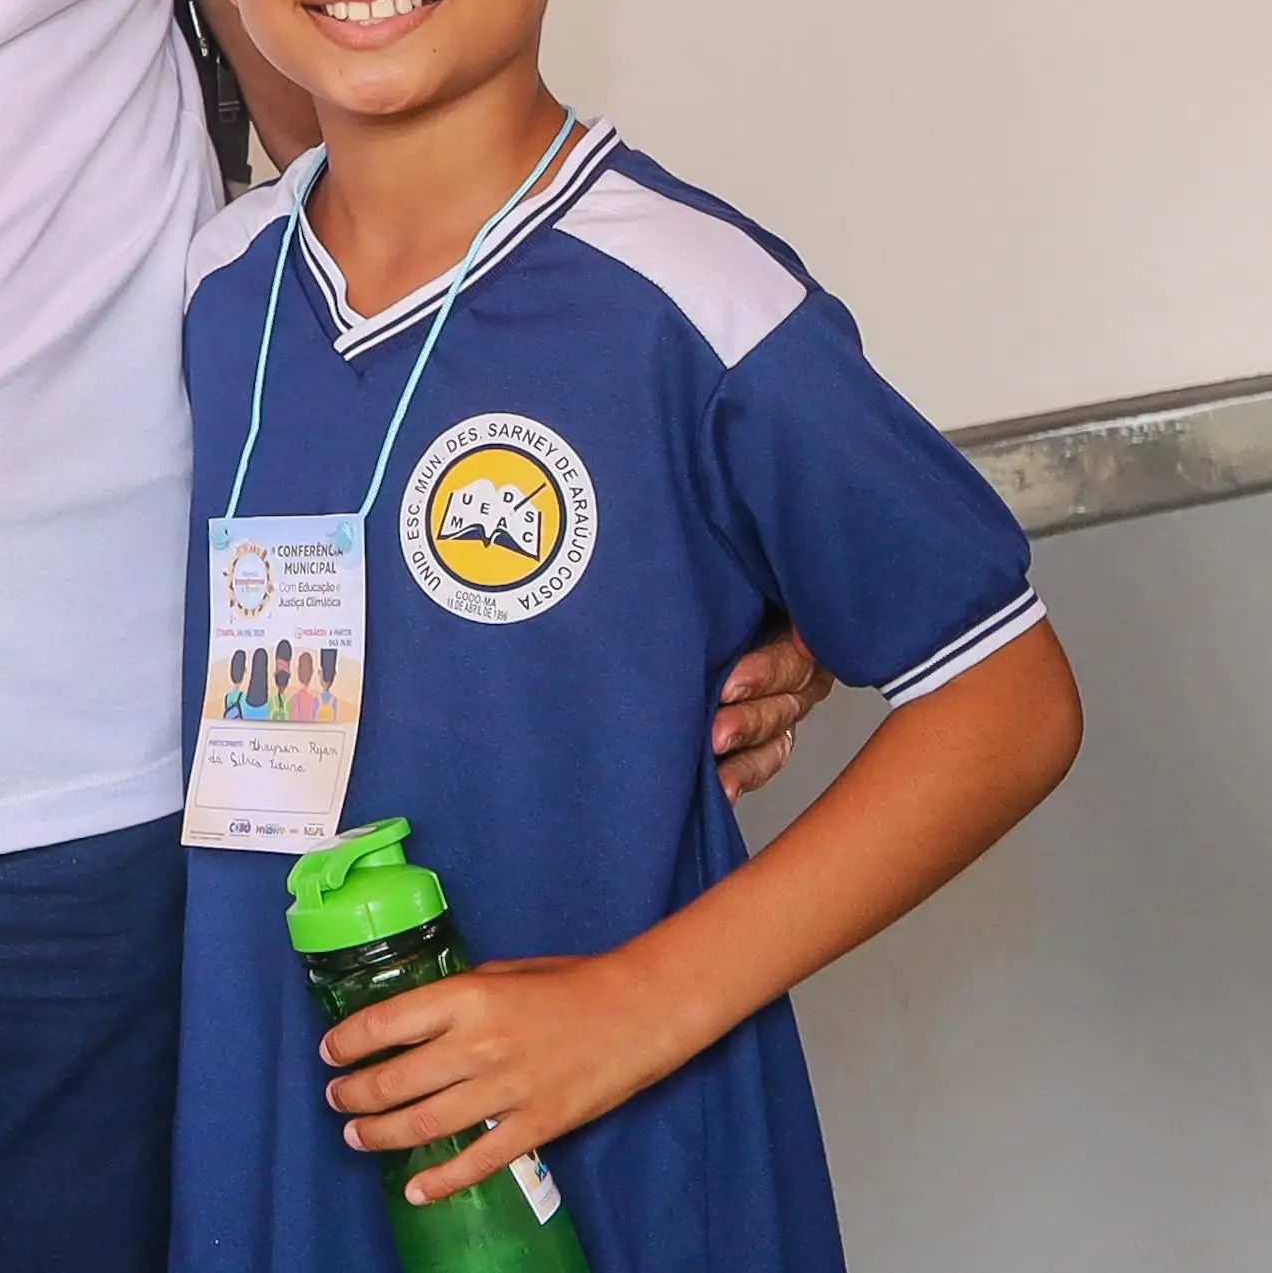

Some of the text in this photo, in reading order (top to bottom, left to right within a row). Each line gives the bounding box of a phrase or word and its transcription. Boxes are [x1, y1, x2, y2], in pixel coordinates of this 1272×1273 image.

[487, 422, 559, 458] SARNEY
[554, 456, 579, 484] DE
[567, 485, 593, 564] ARAÚJO
[283, 561, 337, 575] MUNICIPAL
[298, 581, 335, 595] Educação
[518, 565, 573, 611] COSTA
[278, 597, 341, 610] Justiça Climática
